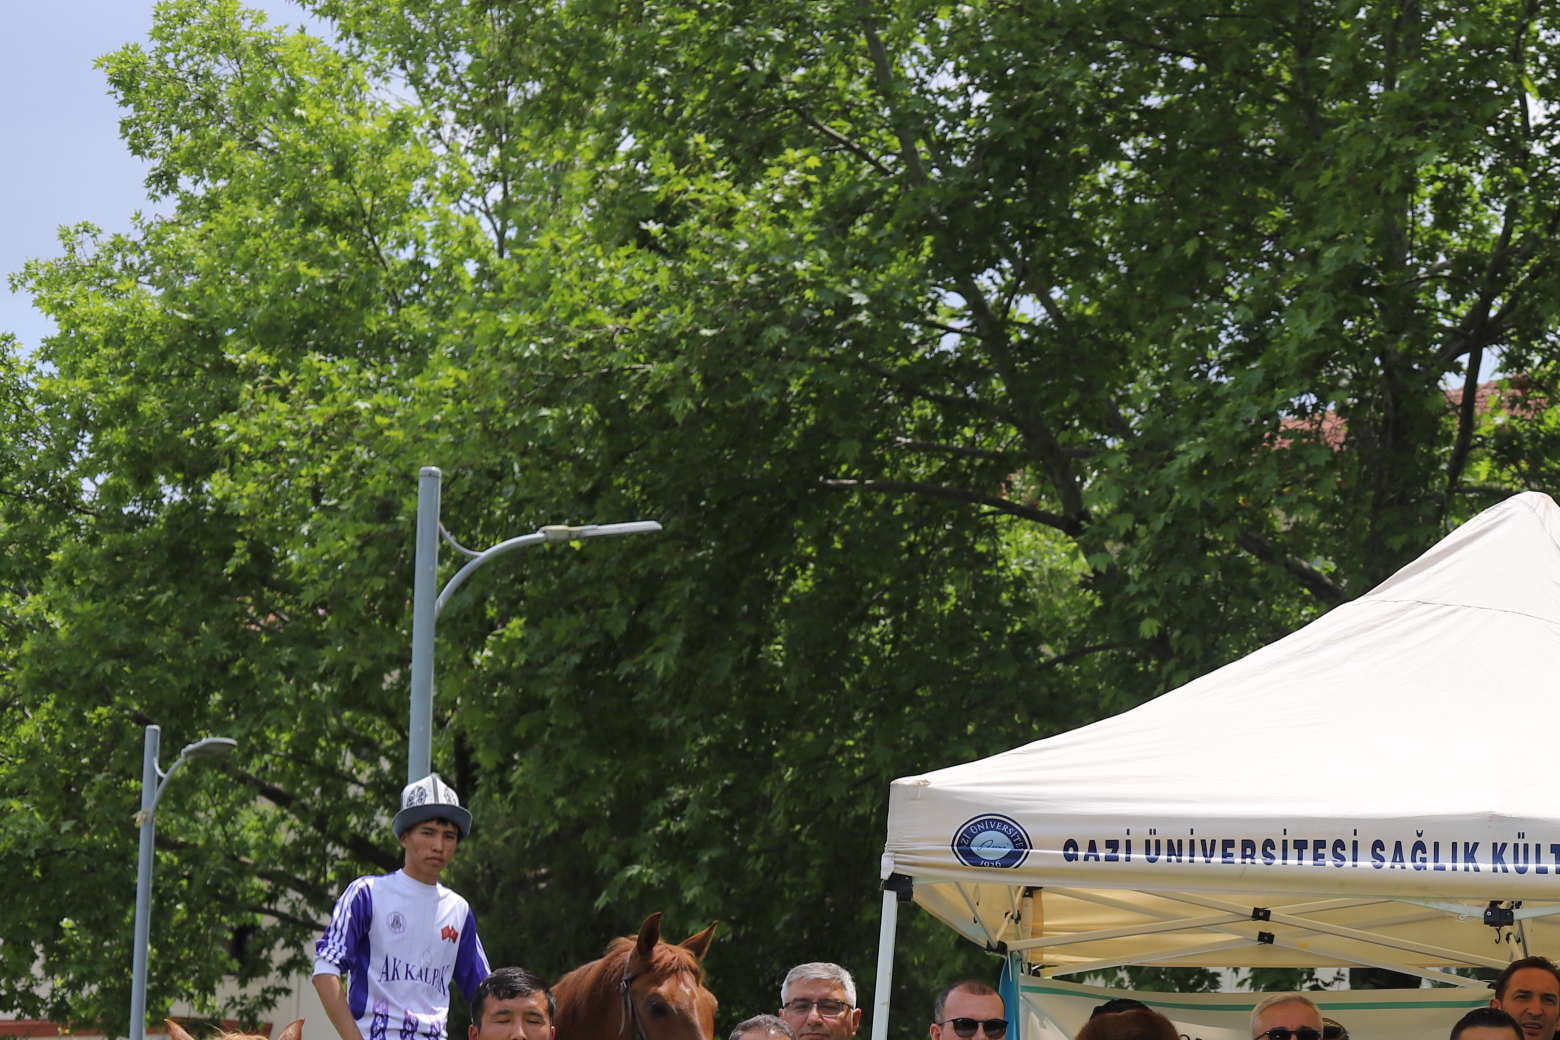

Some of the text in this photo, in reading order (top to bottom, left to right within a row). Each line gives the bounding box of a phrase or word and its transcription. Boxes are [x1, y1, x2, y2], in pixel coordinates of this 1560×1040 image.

[1144, 828, 1359, 868] ÜNİVERSİTESİ
[1371, 829, 1481, 872] SAĞLIK
[378, 953, 402, 983] AK
